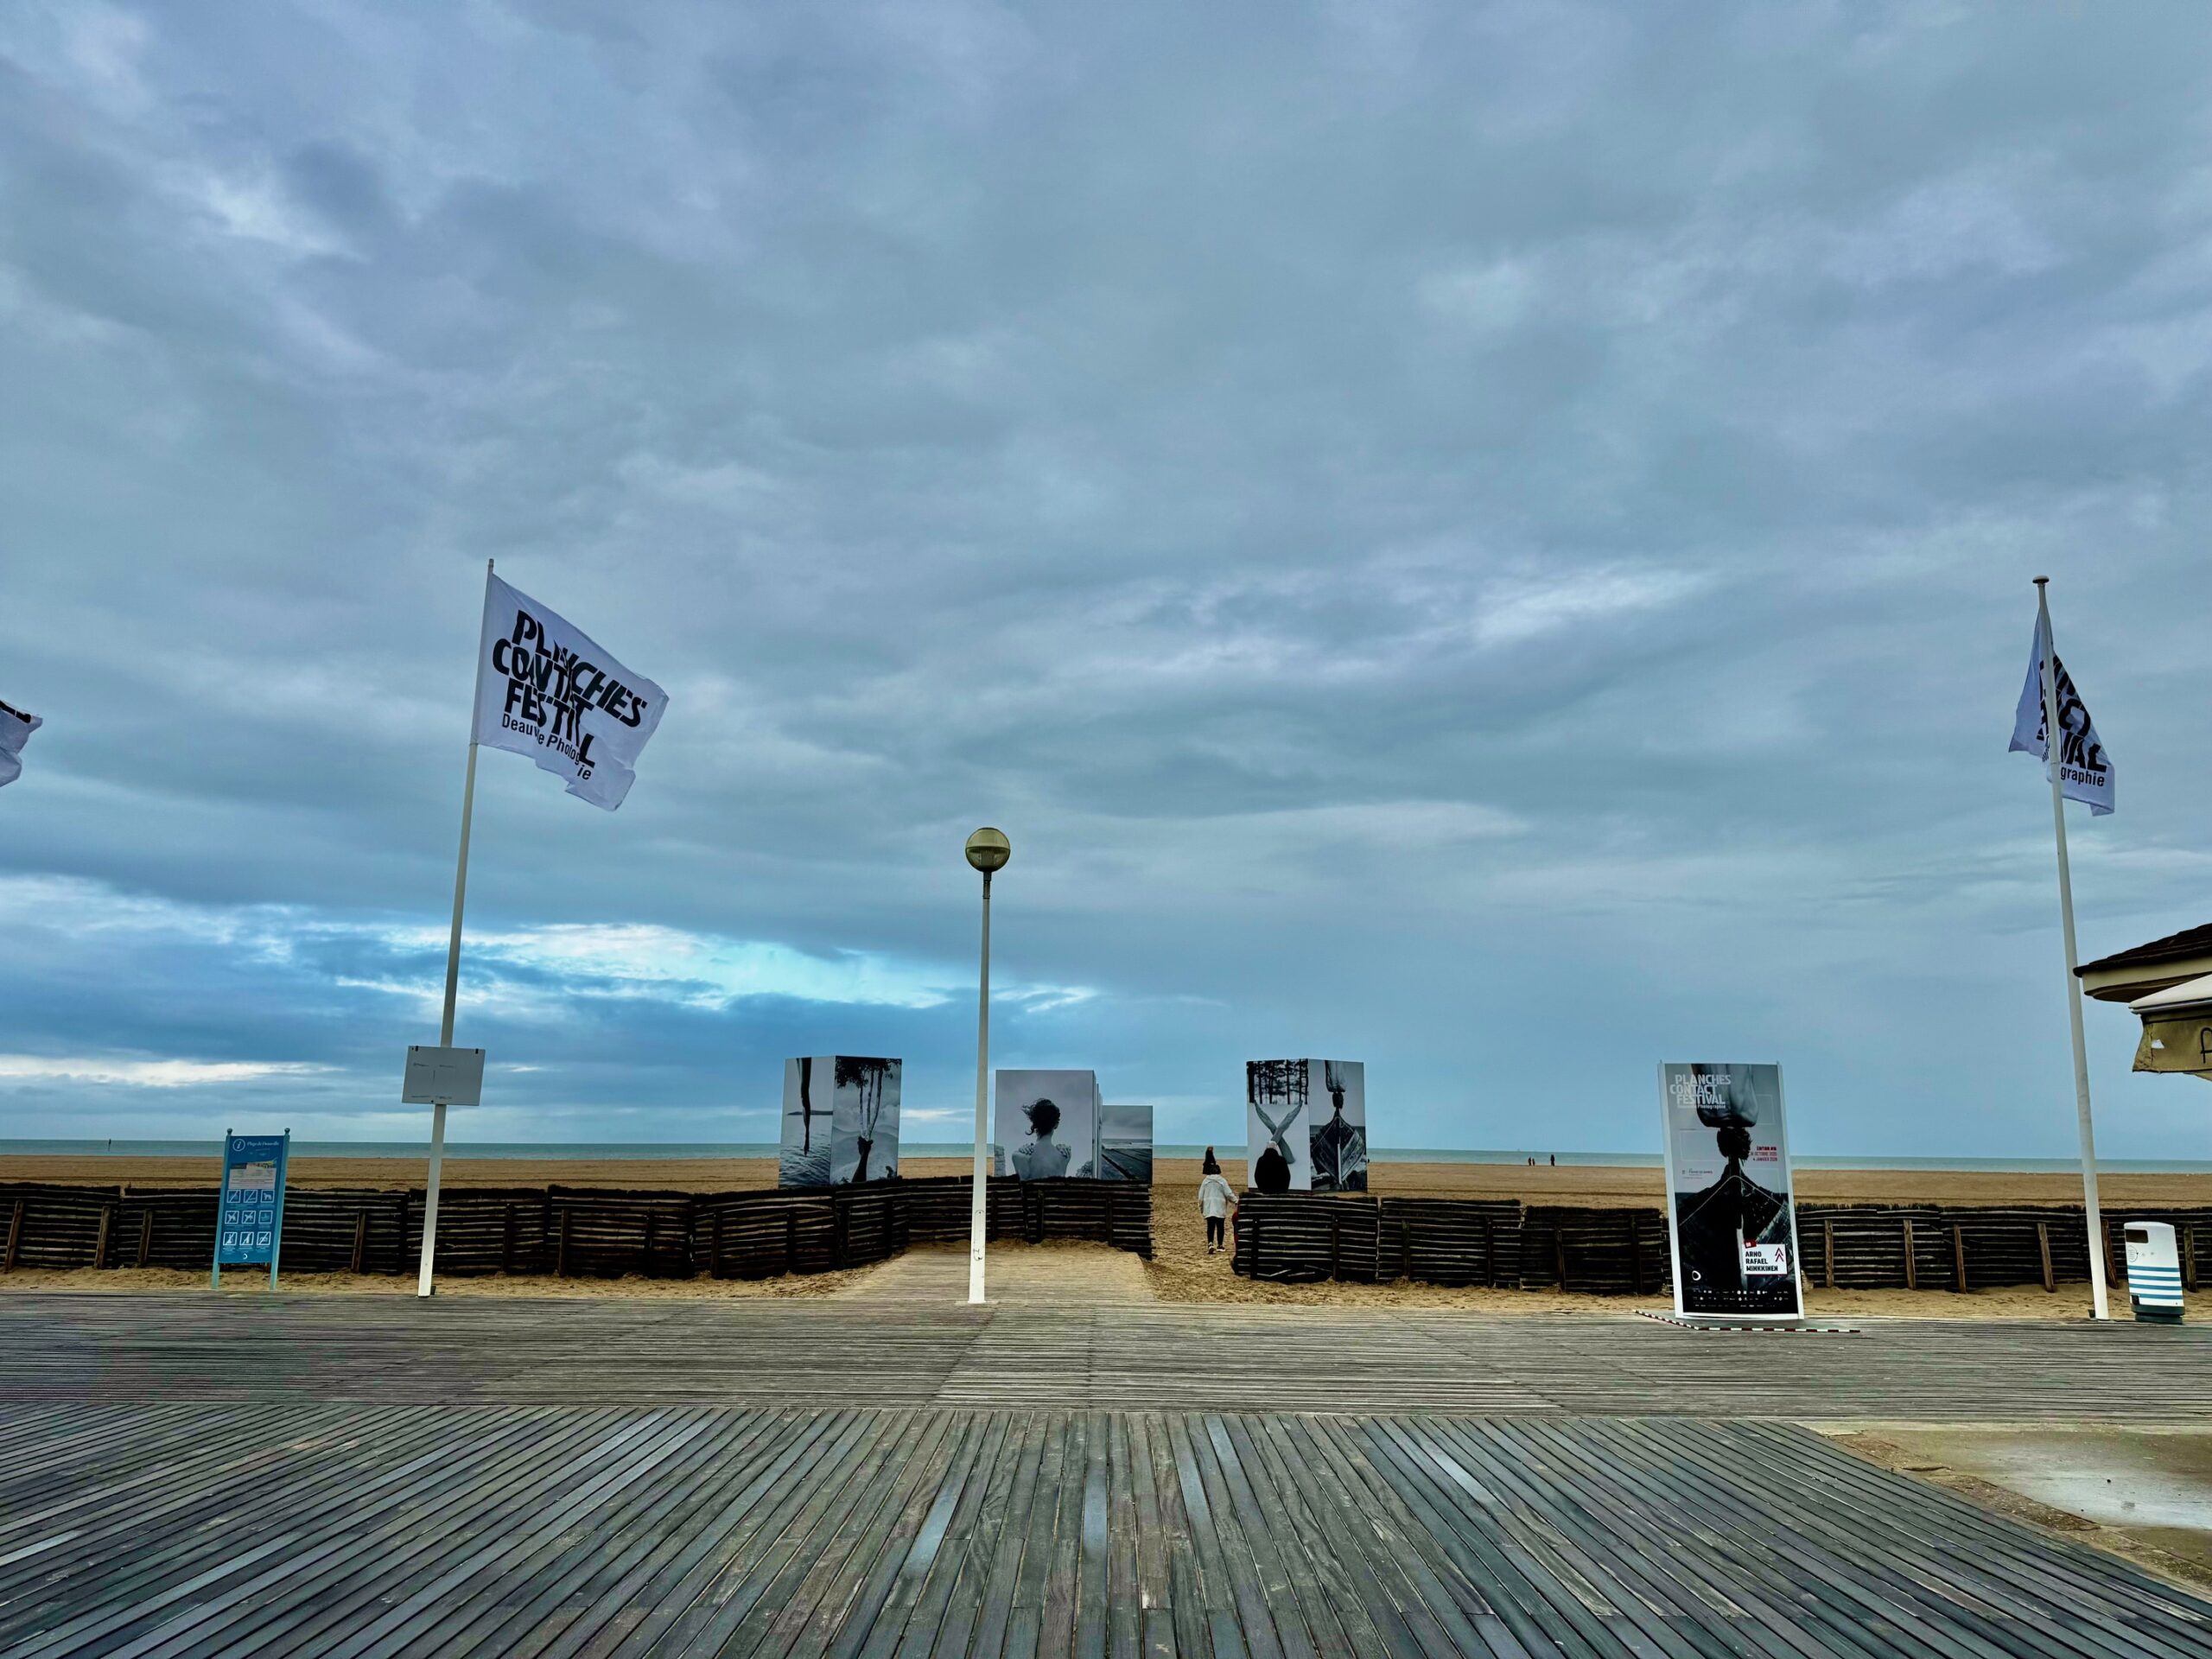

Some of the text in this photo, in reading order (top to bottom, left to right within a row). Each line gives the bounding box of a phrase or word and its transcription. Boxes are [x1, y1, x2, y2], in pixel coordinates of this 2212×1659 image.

[2061, 766, 2106, 788] graphie
[1675, 1074, 1732, 1085] PLANCHES
[1669, 1084, 1718, 1095] CONTACT
[1676, 1095, 1726, 1105] FESTIVAL
